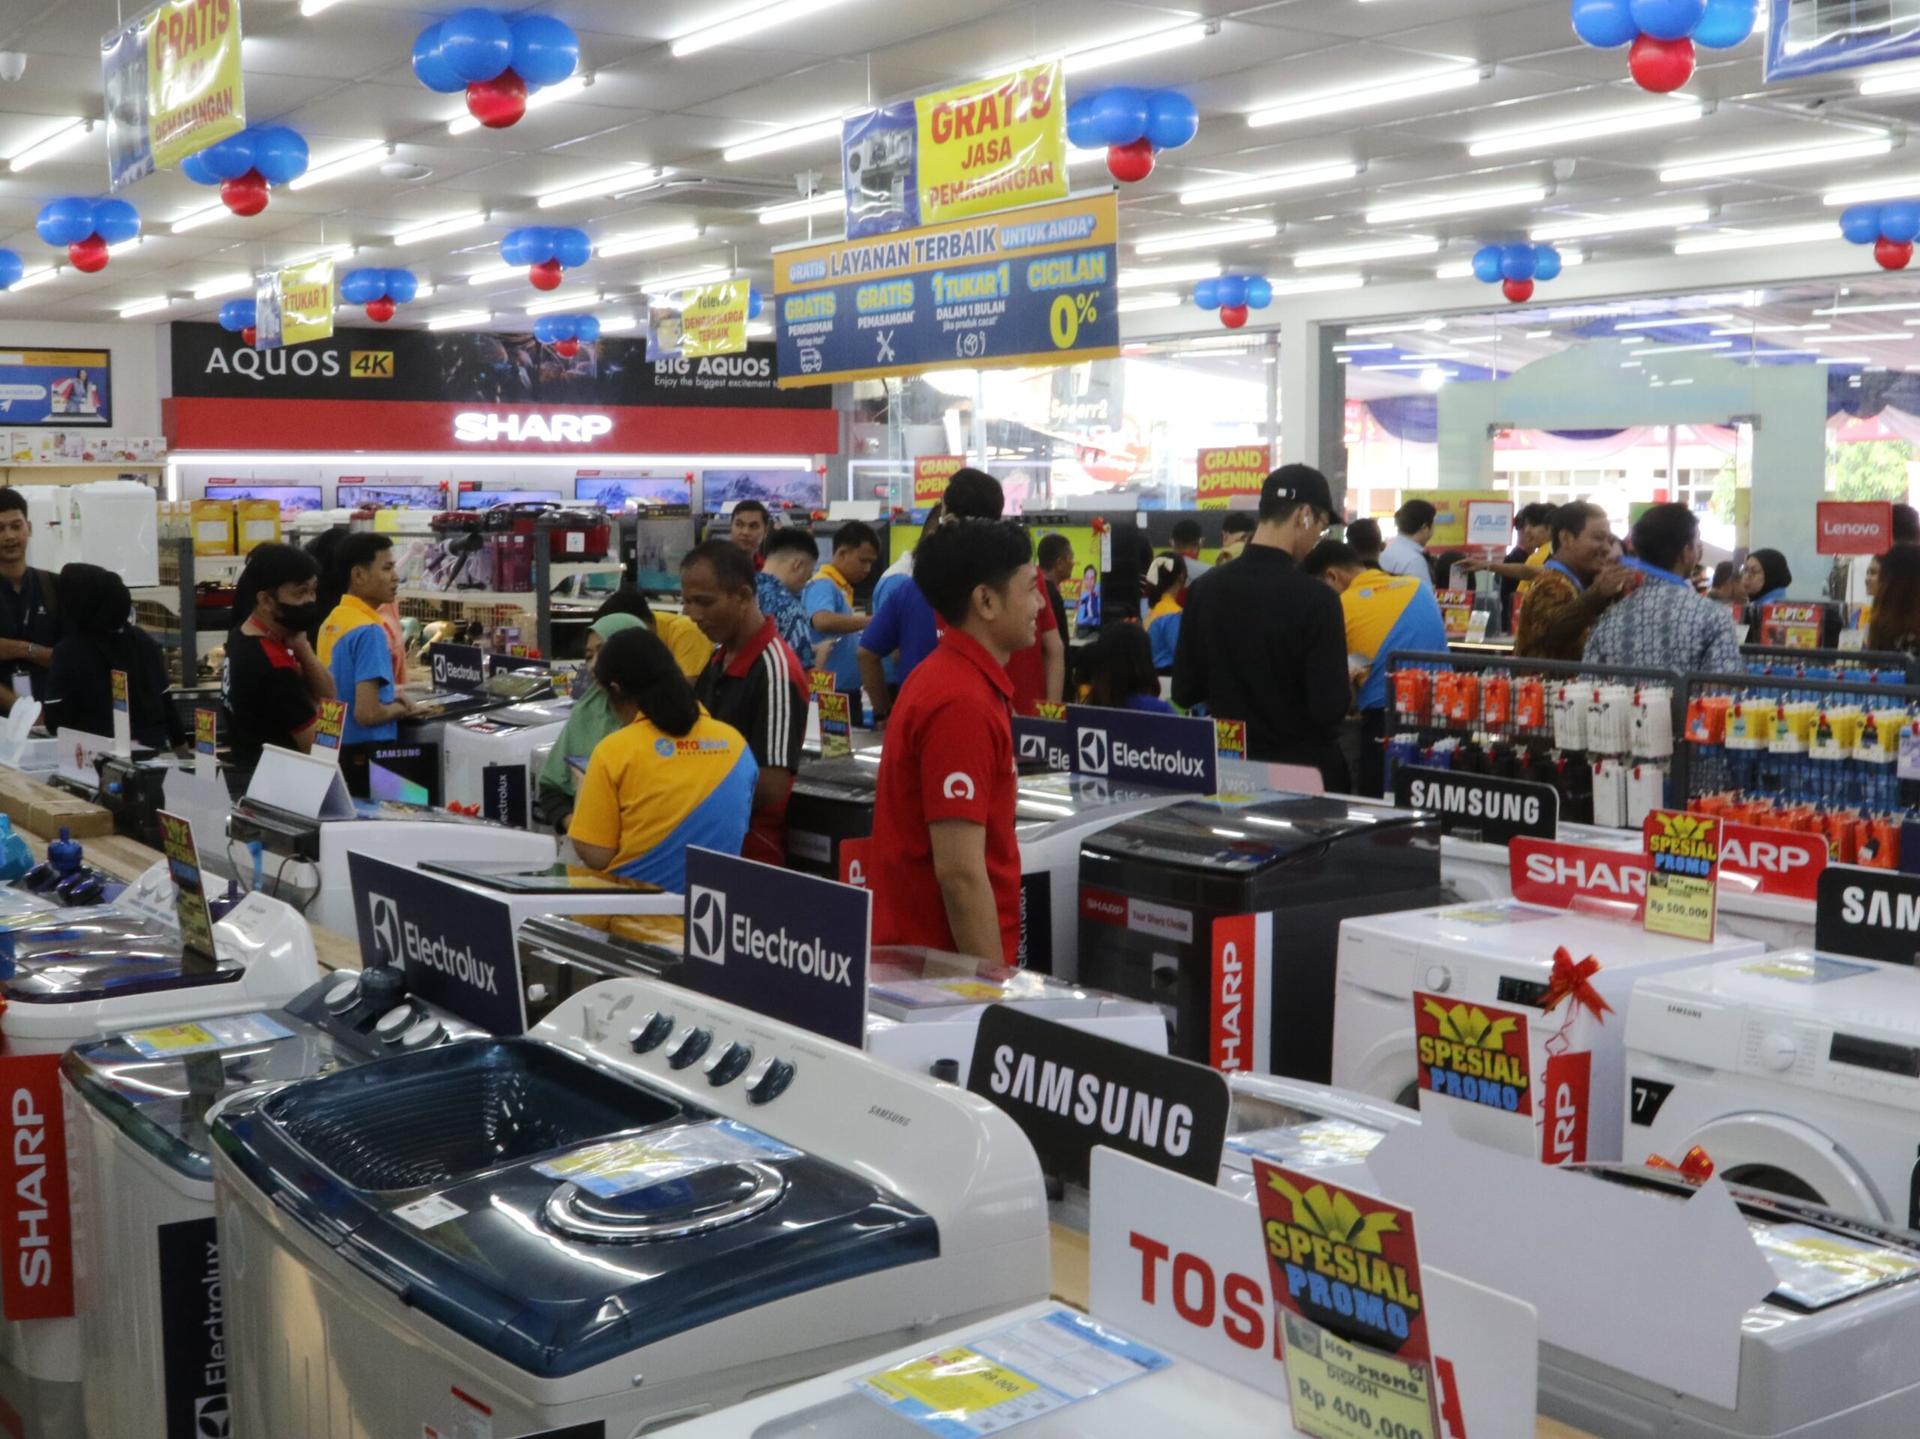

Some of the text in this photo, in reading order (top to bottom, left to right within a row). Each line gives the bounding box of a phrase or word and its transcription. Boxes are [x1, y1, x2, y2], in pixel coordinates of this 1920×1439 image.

[154, 0, 231, 72] GRATIS
[931, 74, 1053, 144] GRATIS
[961, 136, 1012, 169] JASA
[929, 161, 1054, 207] PEMASANGAN
[831, 240, 911, 277] LAYANAN
[914, 225, 998, 263] TERBAIK
[1000, 223, 1046, 245] UNTUK
[945, 271, 997, 299] TUKAR
[1028, 255, 1105, 289] CICILAN
[290, 290, 319, 311] TUKAR
[786, 293, 835, 321] GRATIS
[857, 281, 913, 311] GRATIS
[936, 305, 967, 320] DALAM
[975, 300, 1006, 315] BULAN
[205, 347, 390, 380] AQUOS 4K
[655, 356, 770, 377] BIG AQUOS
[654, 375, 677, 389] Enjoy
[680, 375, 693, 387] the
[695, 376, 726, 390] biggest
[728, 377, 771, 389] excitement
[454, 412, 612, 442] SHARP
[920, 459, 961, 476] GRAND
[1205, 450, 1262, 470] GRAND
[1474, 515, 1507, 527] ASUS
[1823, 520, 1880, 536] Lenovo
[1771, 606, 1815, 620] LAPTOP
[447, 662, 482, 682] Electrolux
[375, 748, 421, 758] SAMSUNG
[1112, 741, 1205, 778] Electrolux
[1410, 779, 1540, 825] SAMSUNG
[1649, 833, 1718, 862] SPESIAL
[1655, 851, 1711, 877] PROMO
[1087, 898, 1124, 916] SHARP
[1650, 899, 1664, 913] Rp
[403, 920, 499, 996] Electrolux
[732, 913, 852, 987] Electrolux
[1221, 941, 1243, 1074] HARP
[1667, 1004, 1702, 1019] SAMSUNG
[1419, 1036, 1529, 1088] SPESIAL
[990, 1044, 1194, 1157] SAMSUNG
[1430, 1066, 1519, 1113] PROMO
[1634, 1087, 1648, 1112] 7
[868, 1104, 912, 1128] SAMSUNG
[12, 1087, 51, 1288] SHARP
[1265, 1219, 1420, 1310] SPESIAL
[1129, 1230, 1284, 1361] TOS
[1284, 1263, 1409, 1339] PROMO
[201, 1240, 228, 1386] Electrolux
[1325, 1339, 1420, 1395] HOT PROMO
[1326, 1364, 1379, 1399] DISKON
[1297, 1377, 1326, 1411] Rp
